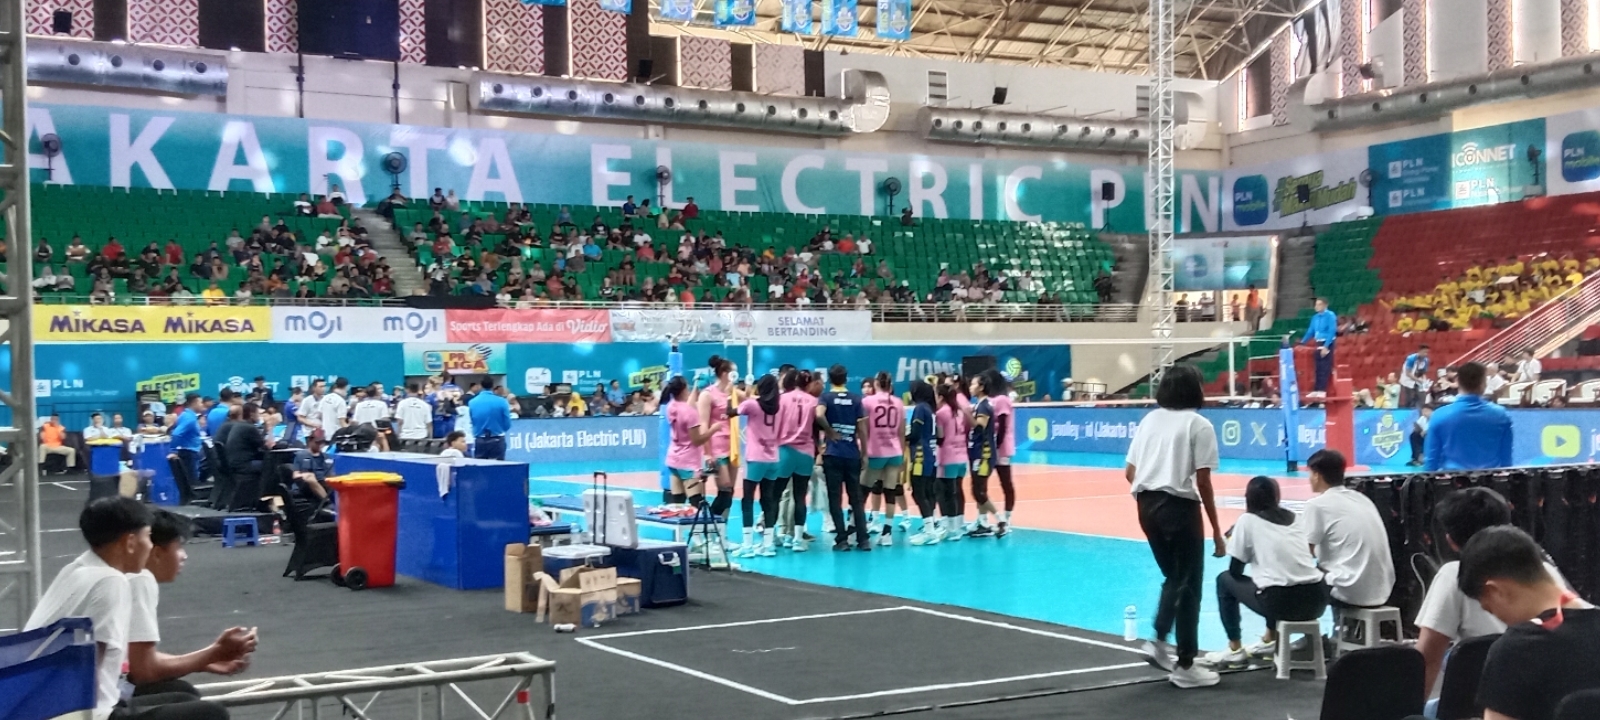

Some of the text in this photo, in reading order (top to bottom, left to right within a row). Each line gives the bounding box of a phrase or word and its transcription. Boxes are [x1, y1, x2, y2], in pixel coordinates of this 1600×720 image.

[1452, 144, 1516, 168] ICONNET
[591, 143, 1043, 222] ELECTRIC
[451, 321, 481, 332] Sports
[483, 321, 534, 332] Terlengkap
[537, 321, 554, 331] Ada
[556, 321, 565, 331] di
[566, 319, 608, 333] Vidio
[778, 316, 825, 326] SELAMAT
[767, 327, 837, 337] BERTANDING
[444, 360, 486, 370] LIGA
[579, 370, 602, 378] PLN
[52, 379, 84, 389] PLN
[875, 405, 898, 429] 20
[525, 431, 574, 452] (Jakarta
[577, 430, 619, 447] Electric
[622, 428, 647, 448] PLN)
